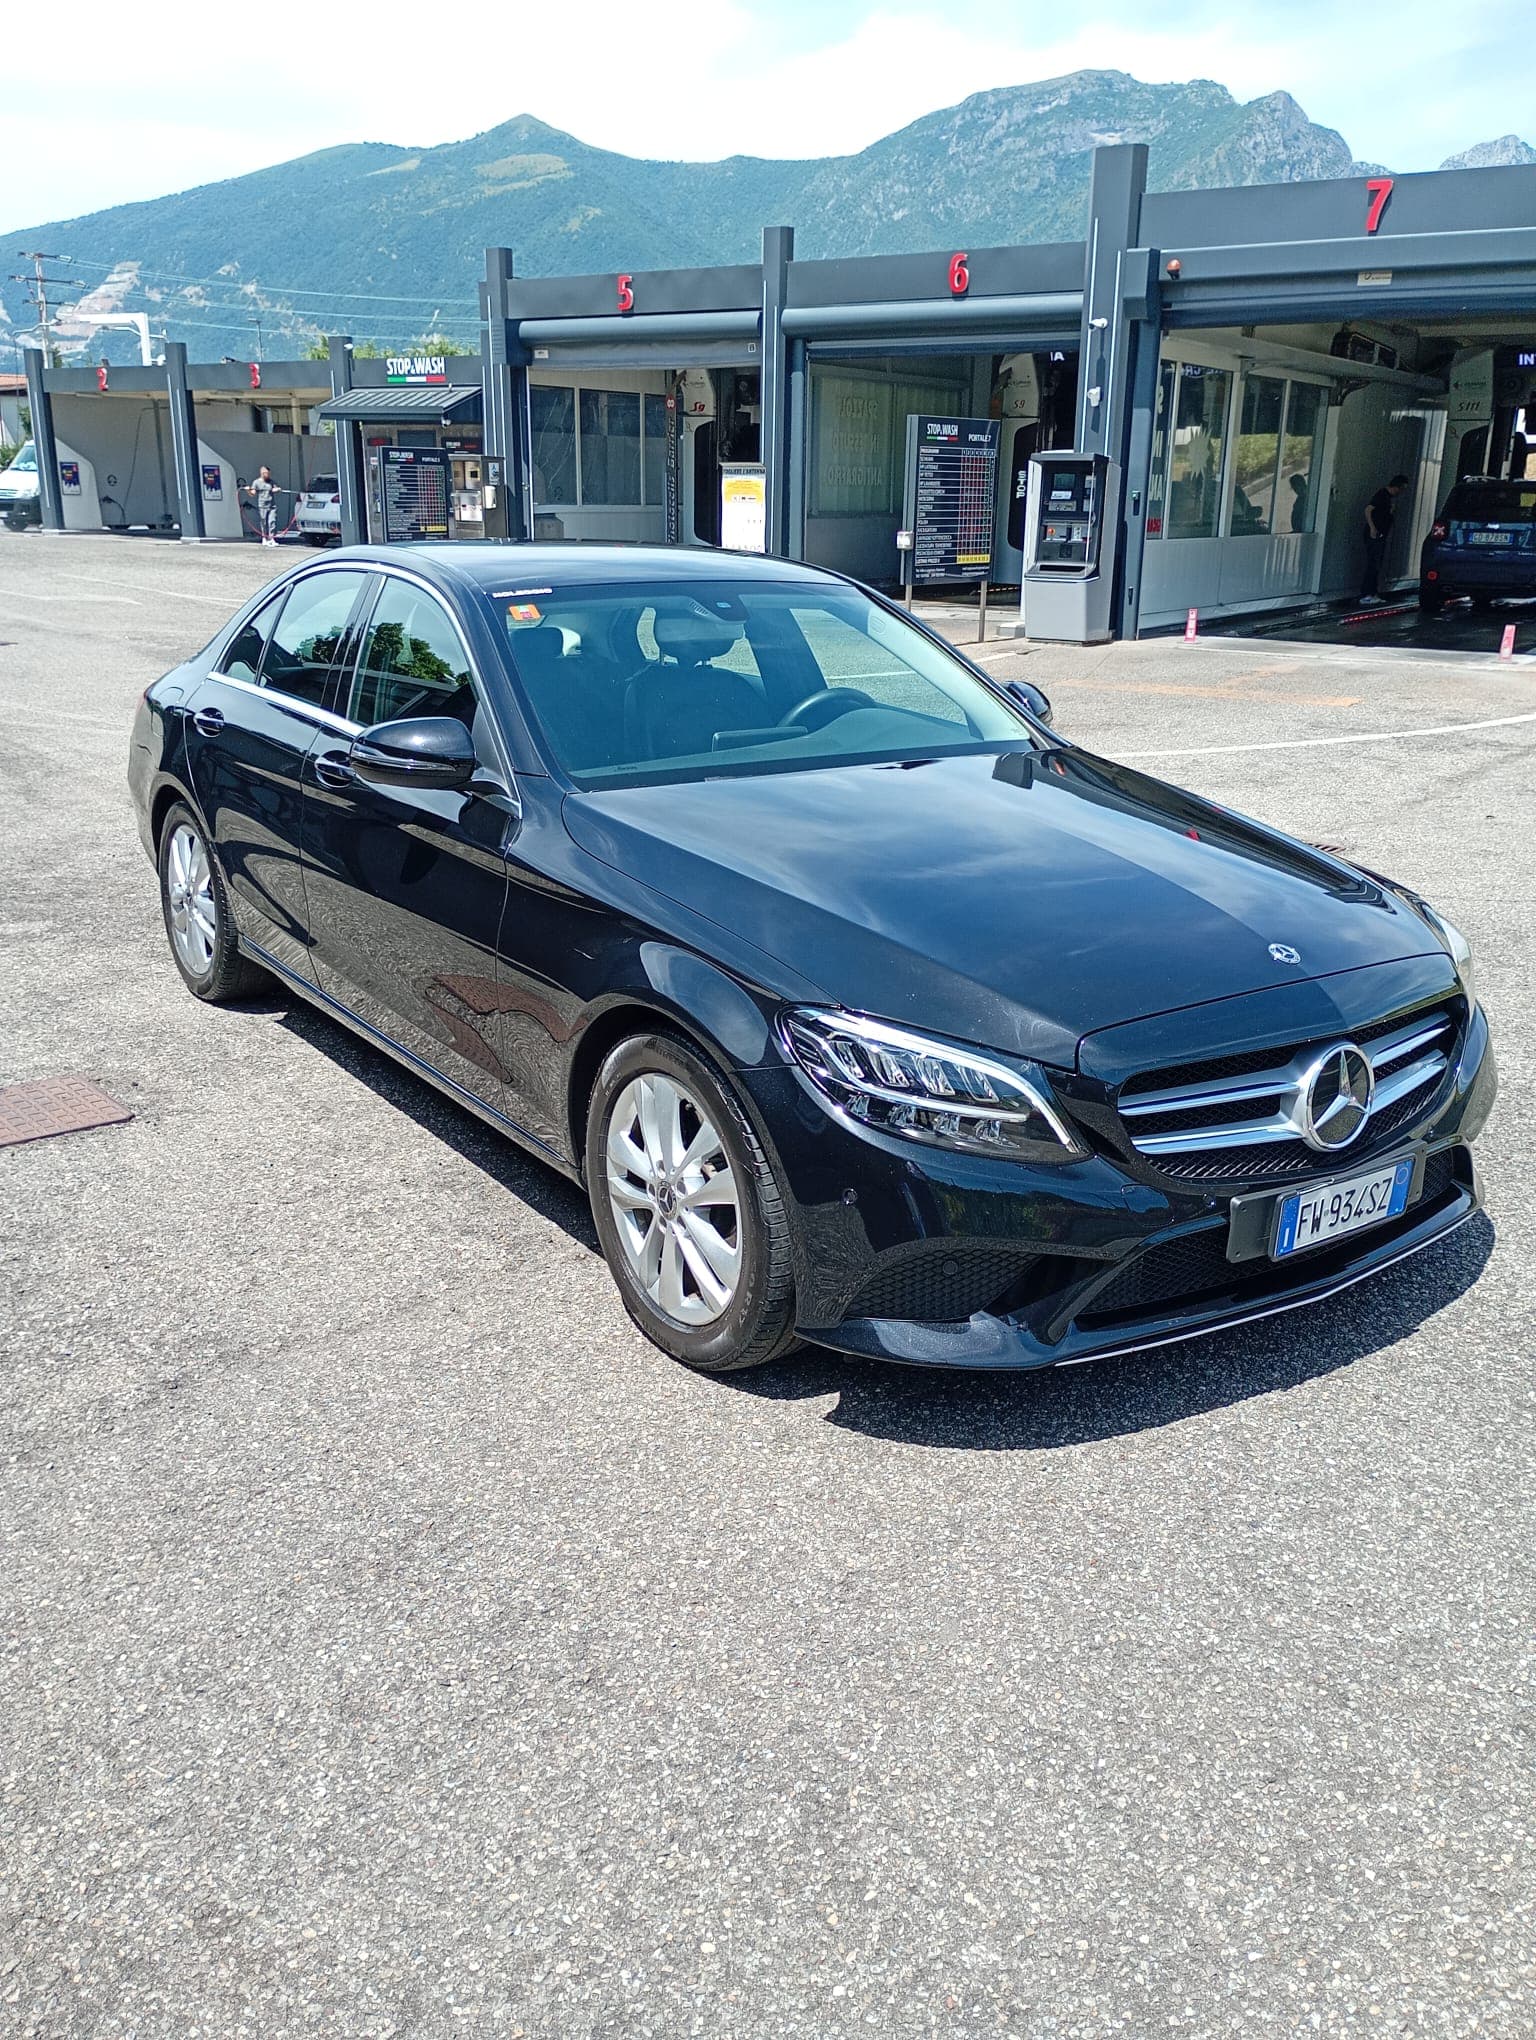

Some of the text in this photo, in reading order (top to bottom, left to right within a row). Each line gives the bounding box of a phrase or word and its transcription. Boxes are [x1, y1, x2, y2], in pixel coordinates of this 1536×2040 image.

[1366, 179, 1394, 232] 7
[948, 253, 970, 293] 6
[617, 275, 634, 311] 5
[386, 356, 446, 375] STOP&WASH
[1519, 353, 1536, 366] IN
[96, 367, 108, 391] 2
[248, 363, 261, 389] 3
[1015, 470, 1027, 499] STOP
